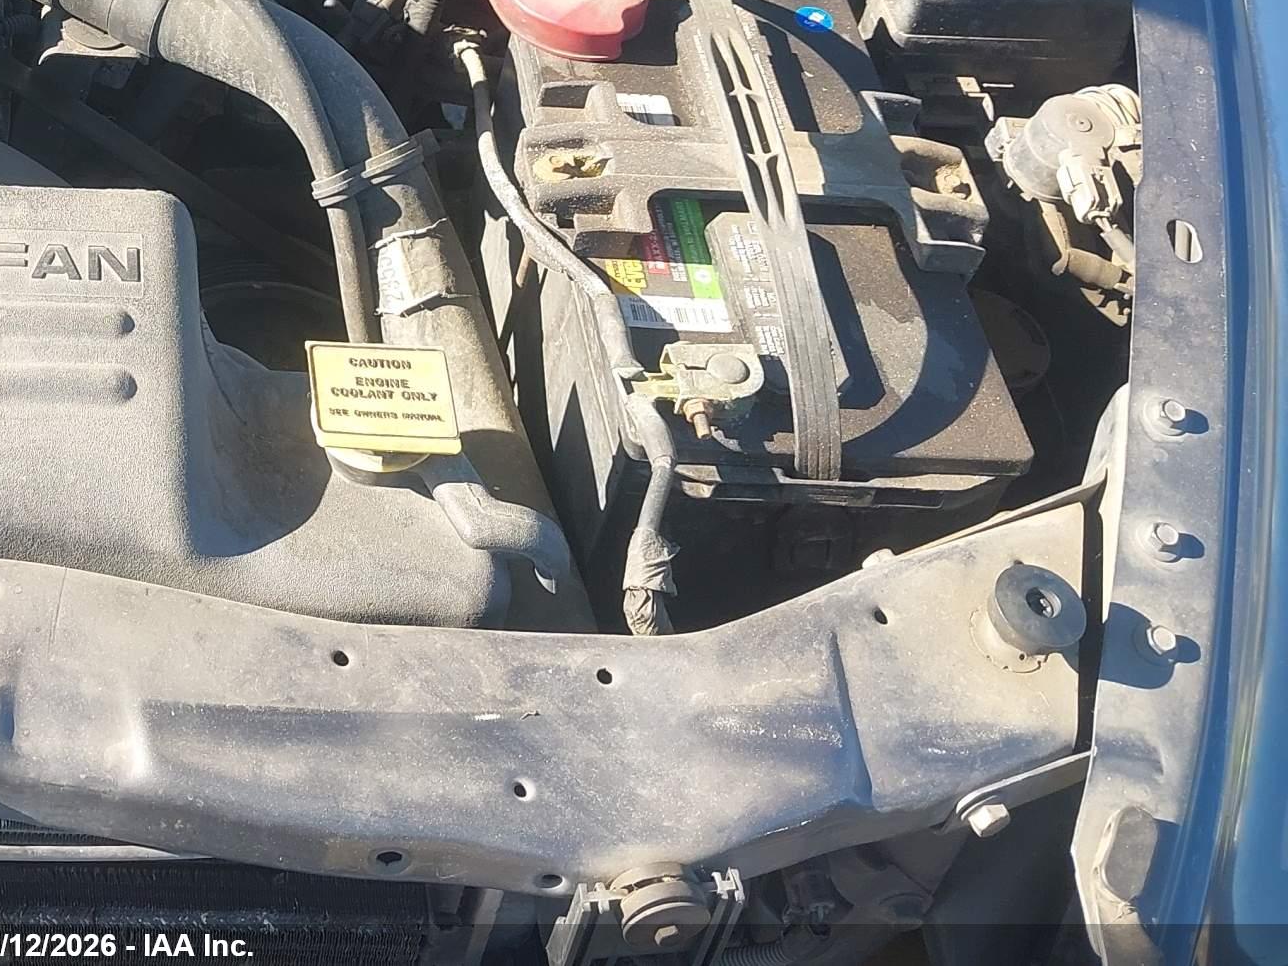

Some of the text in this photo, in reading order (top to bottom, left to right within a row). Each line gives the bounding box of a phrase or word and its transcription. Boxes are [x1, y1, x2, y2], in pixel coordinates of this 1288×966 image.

[349, 357, 412, 370] CAUTION
[355, 376, 410, 389] ENGINE
[330, 386, 438, 402] COOLANT ONLY
[328, 407, 349, 417] SEE
